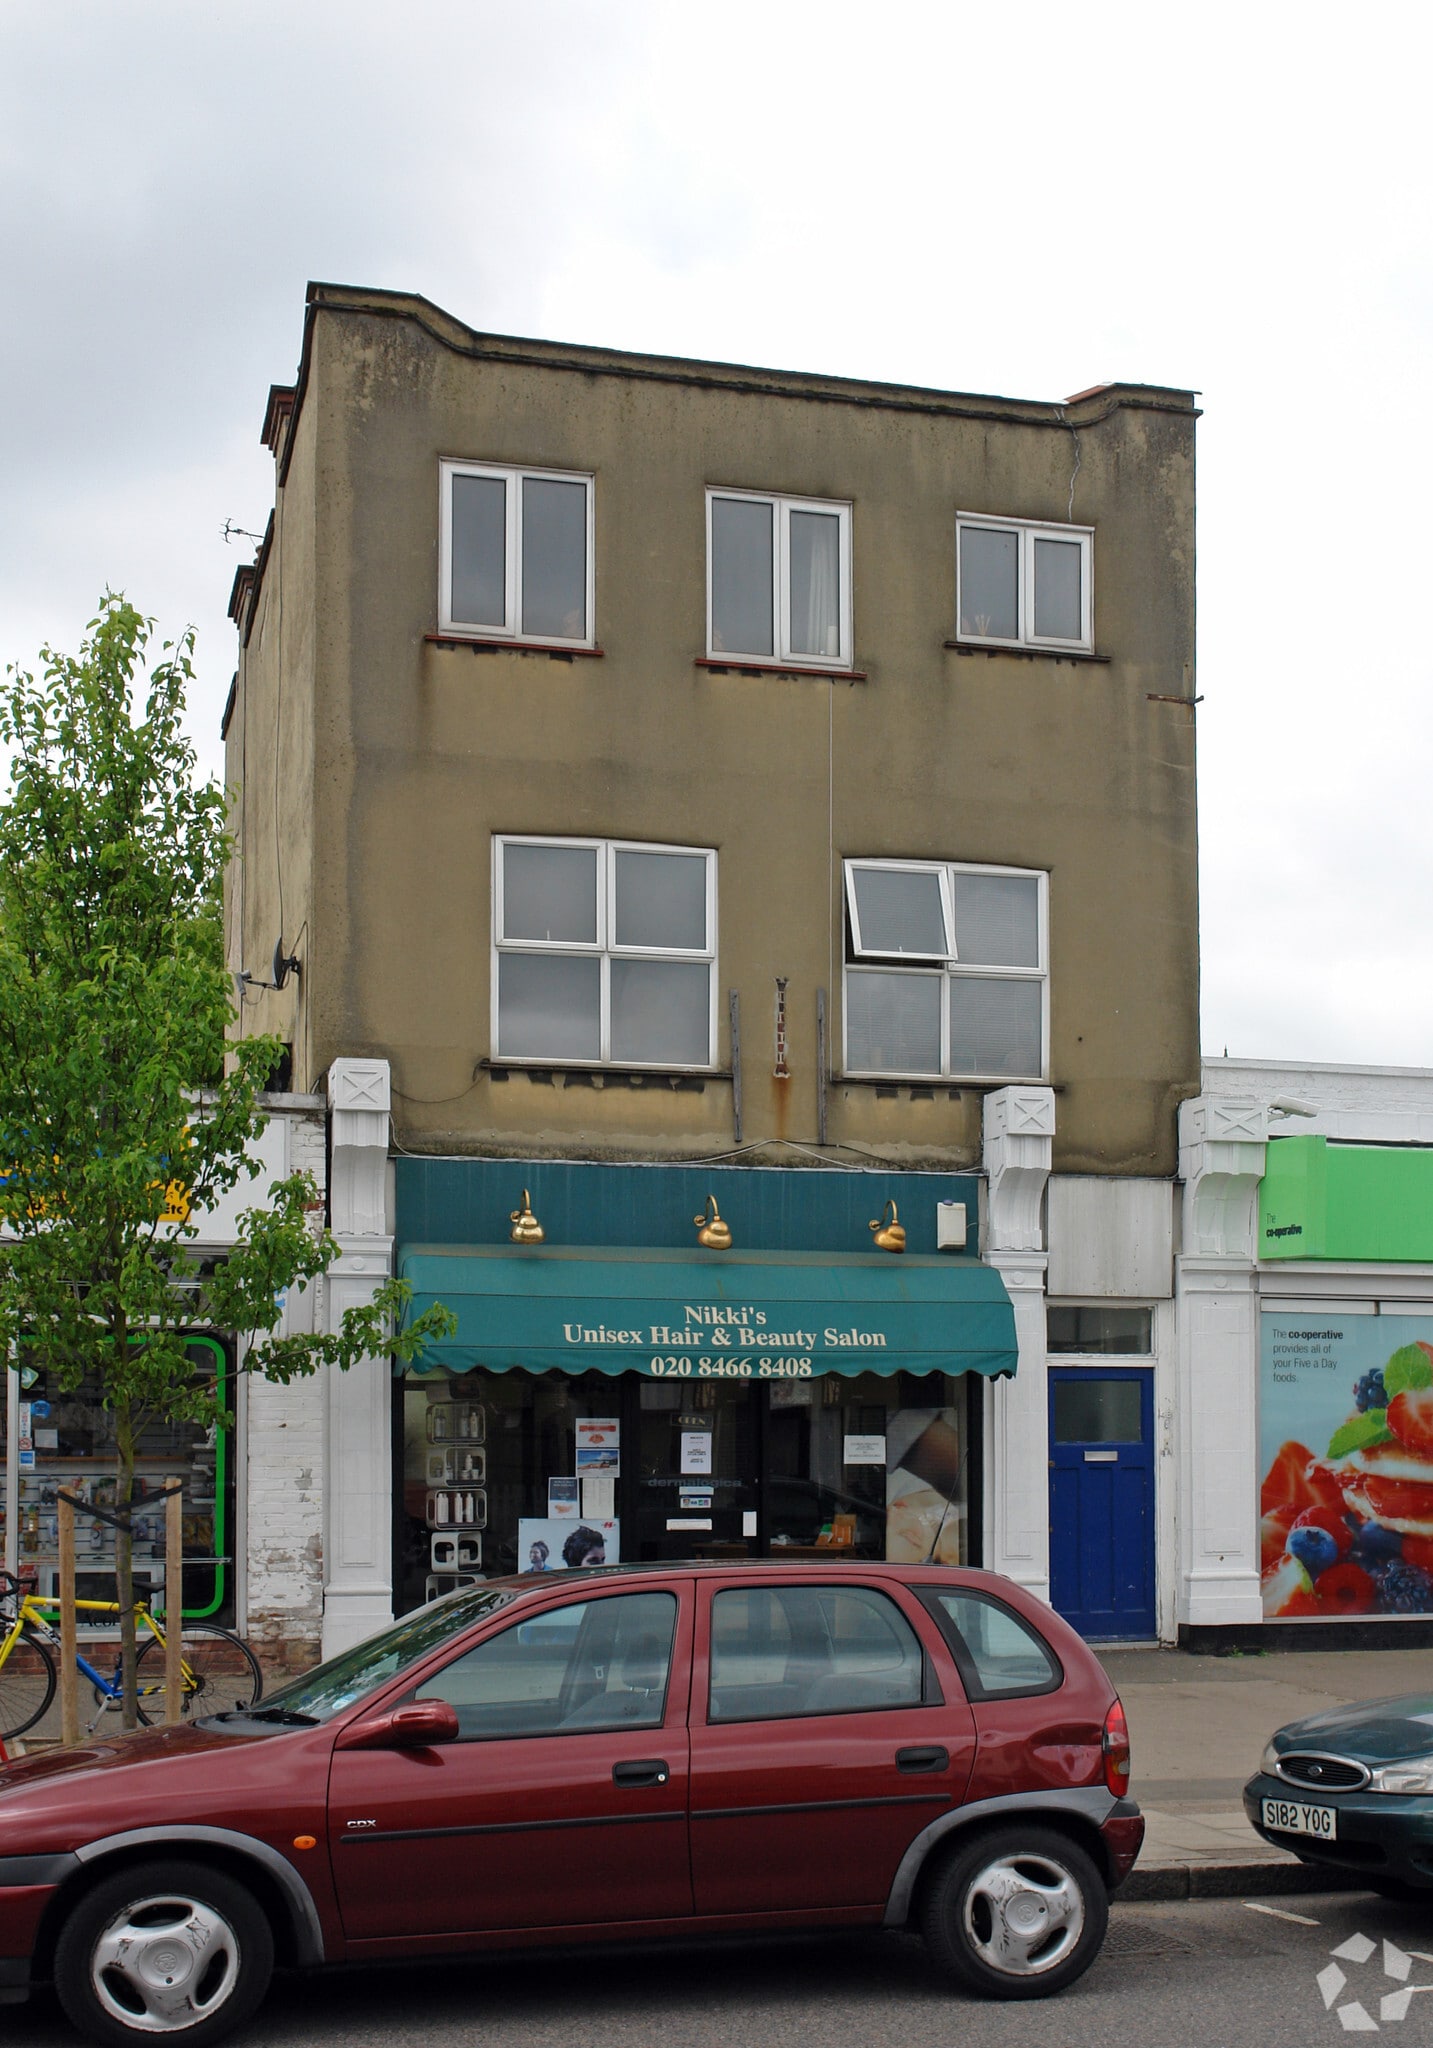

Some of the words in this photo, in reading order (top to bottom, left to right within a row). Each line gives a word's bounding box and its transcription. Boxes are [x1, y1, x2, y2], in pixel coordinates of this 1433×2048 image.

[1266, 1223, 1303, 1239] co-operative
[684, 1305, 767, 1326] Nikki's
[563, 1324, 643, 1344] Unisex
[650, 1326, 703, 1346] Hair
[711, 1327, 732, 1346] &
[739, 1328, 817, 1351] Beauty
[824, 1328, 887, 1347] Salon
[1272, 1328, 1287, 1339] The
[1288, 1330, 1343, 1341] co-operative
[1272, 1344, 1309, 1355] provides
[1311, 1344, 1321, 1353] all
[1323, 1344, 1332, 1354] of
[650, 1356, 692, 1376] 020
[699, 1357, 752, 1376] 8466
[758, 1357, 812, 1376] 8408
[1273, 1360, 1290, 1370] your
[1294, 1358, 1311, 1368] Five
[1313, 1360, 1319, 1368] a
[1321, 1359, 1337, 1370] Day
[346, 1819, 377, 1829] CDX
